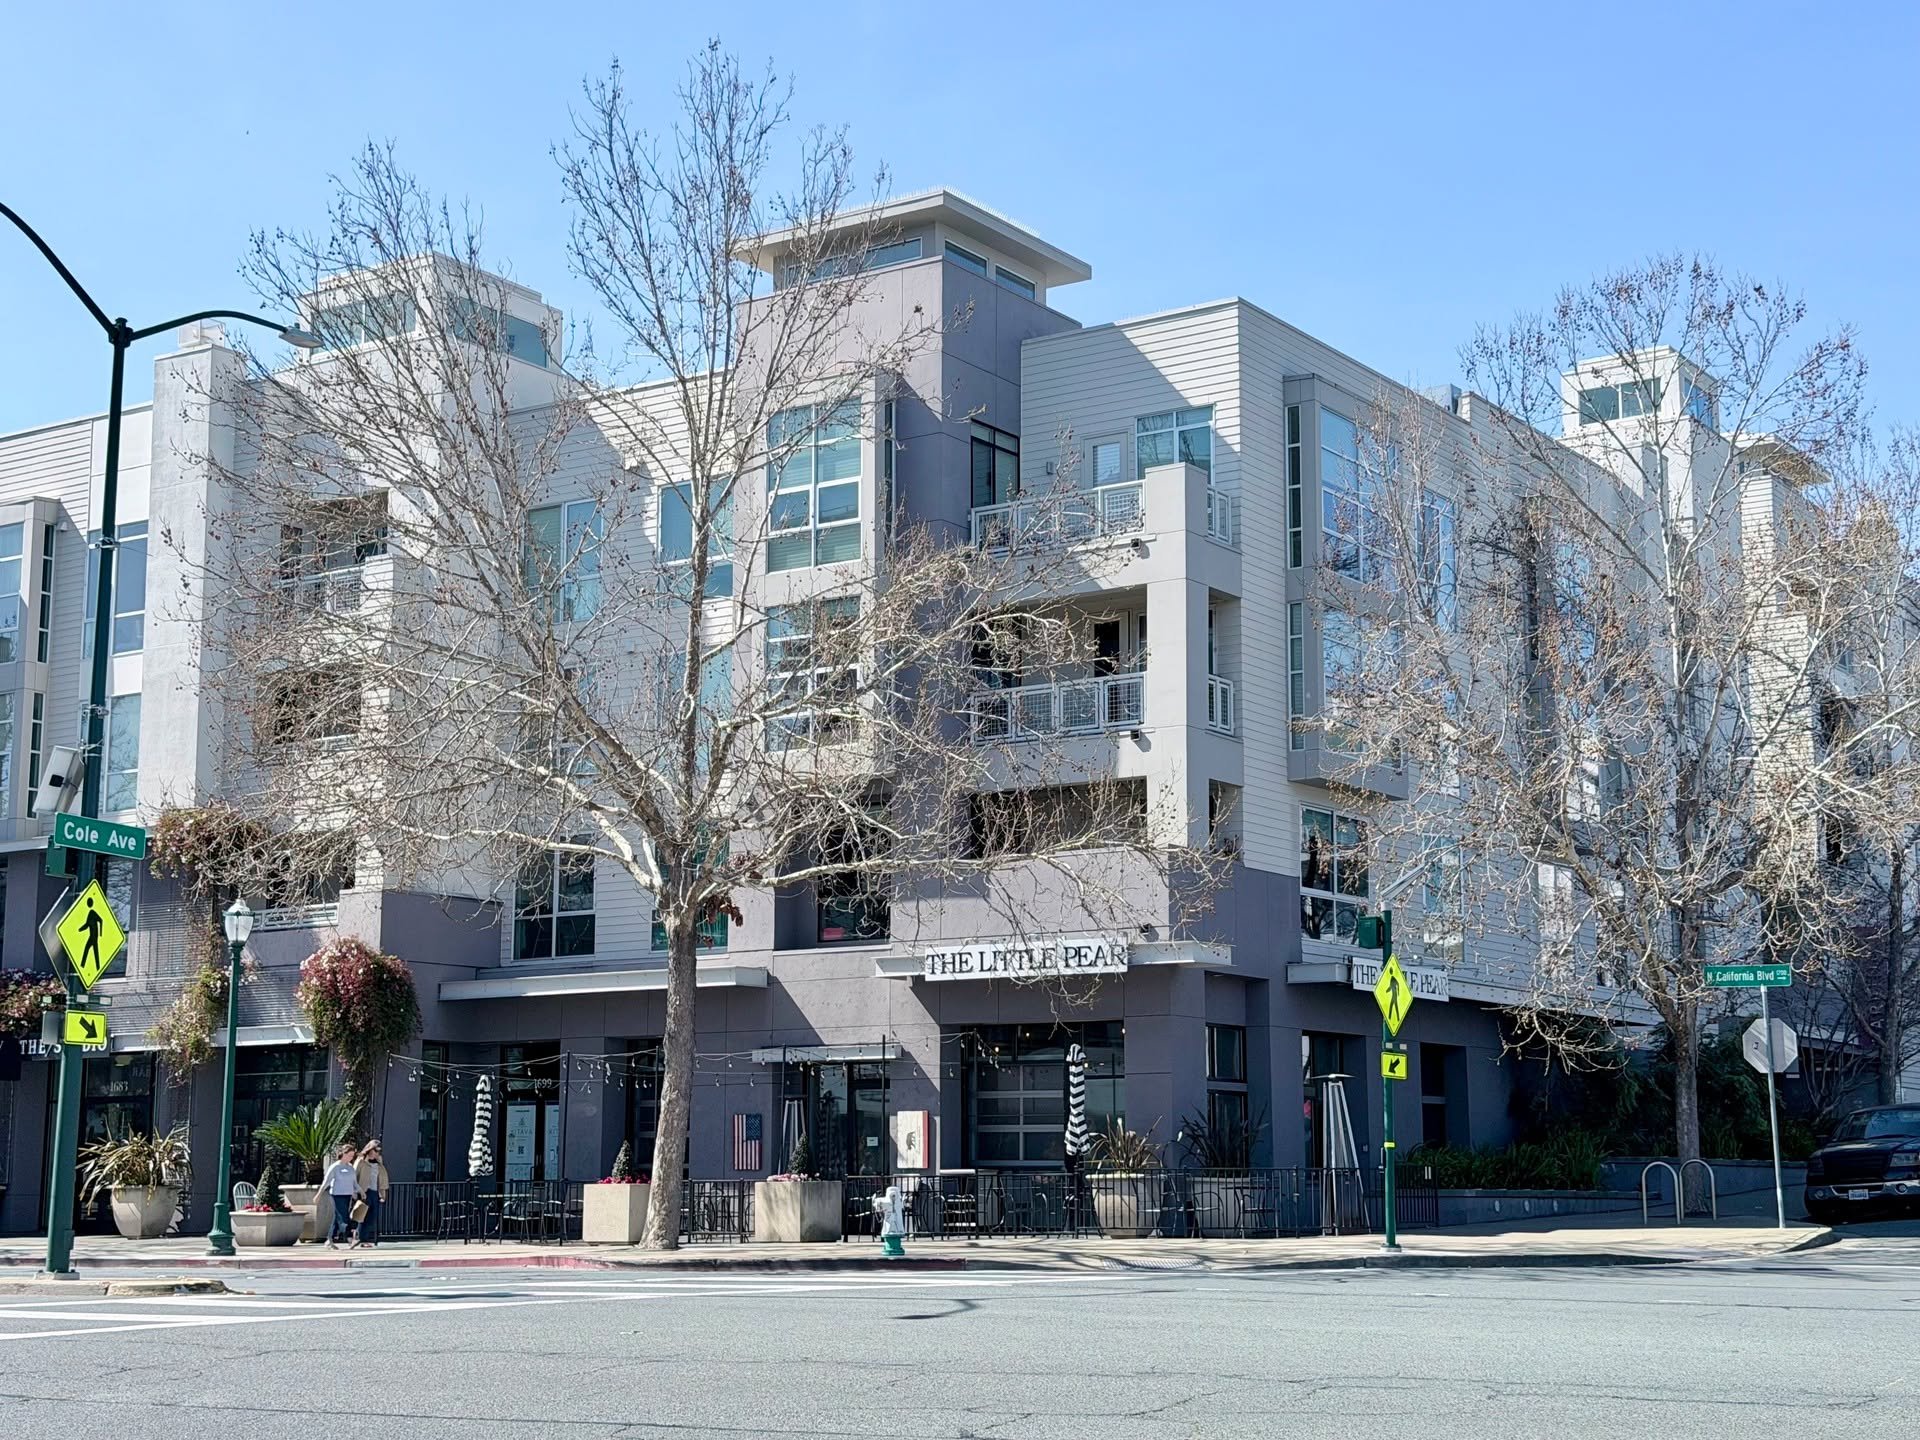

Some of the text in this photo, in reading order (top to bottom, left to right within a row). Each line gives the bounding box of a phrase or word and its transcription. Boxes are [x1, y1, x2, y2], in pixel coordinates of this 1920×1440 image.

[64, 821, 137, 851] Cole Ave
[926, 945, 1127, 975] THE LITTLE PEAR
[1353, 964, 1378, 986] THE
[1420, 973, 1449, 996] PEAR
[1716, 970, 1754, 982] California
[1757, 970, 1775, 982] Blvd
